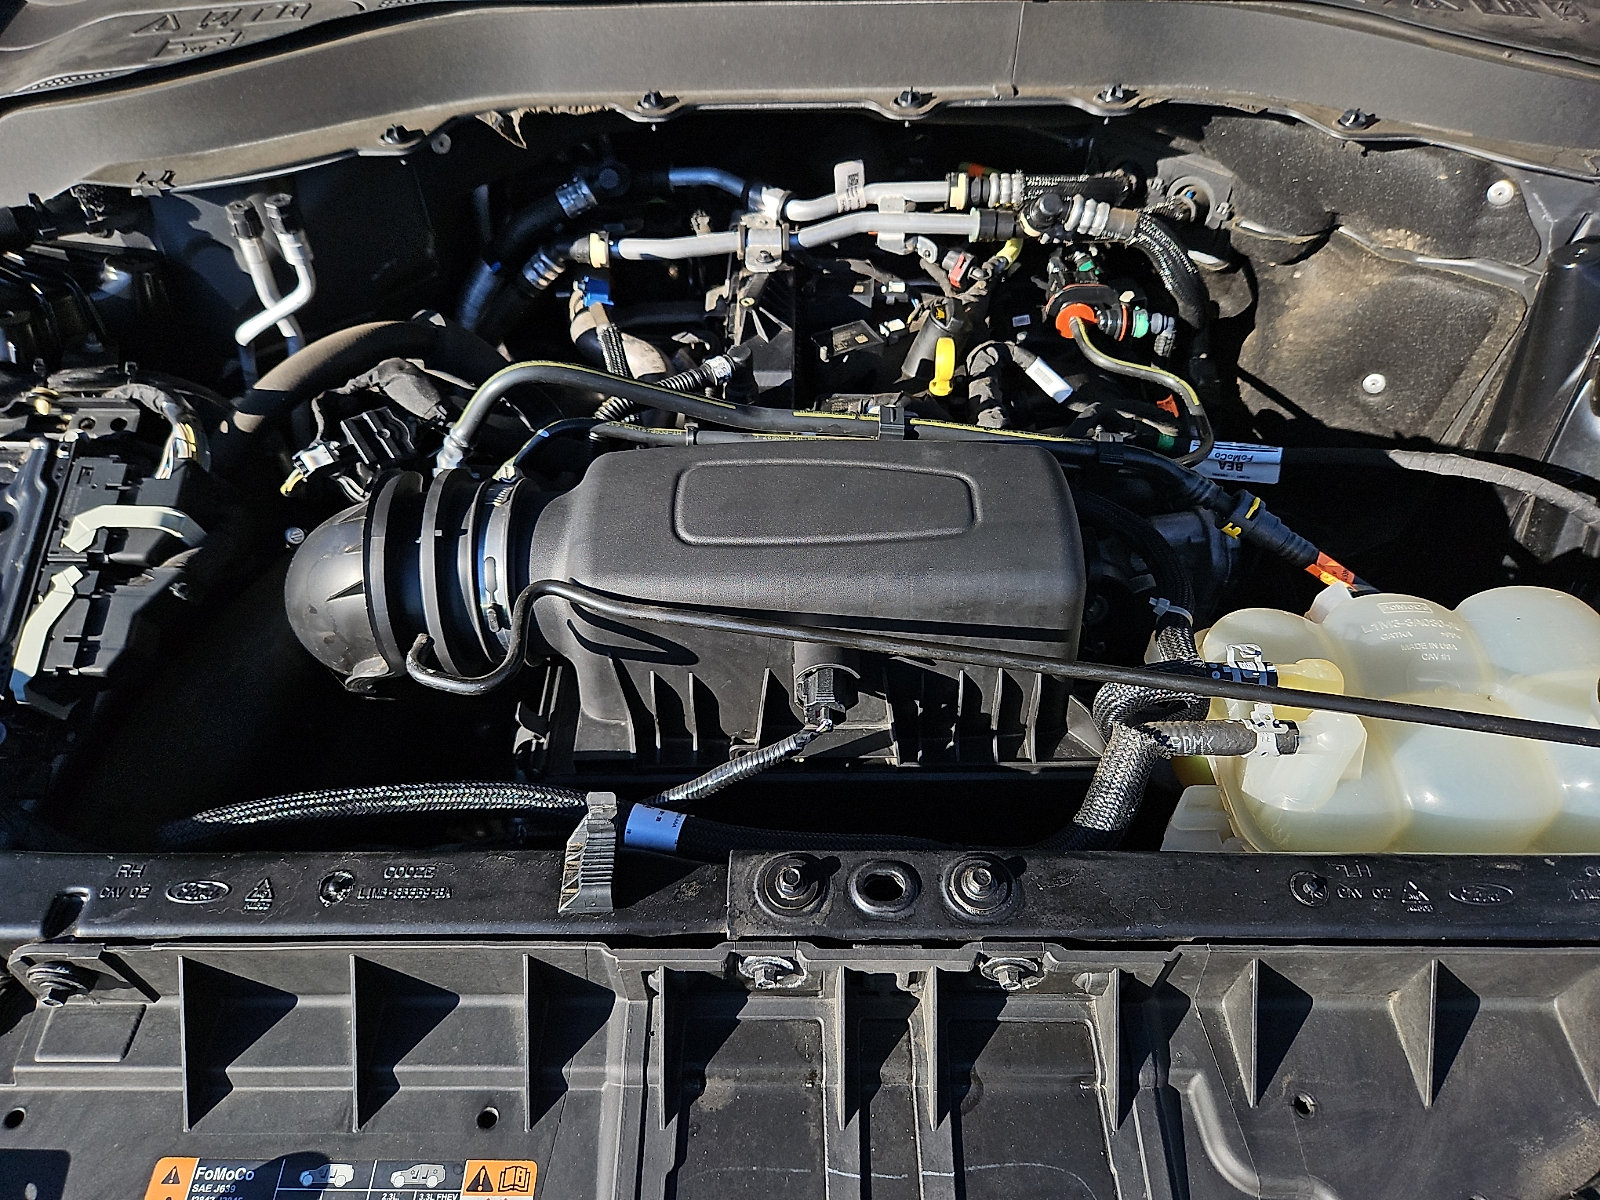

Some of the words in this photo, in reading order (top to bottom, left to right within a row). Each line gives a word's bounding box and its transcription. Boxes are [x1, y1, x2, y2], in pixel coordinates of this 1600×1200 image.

[1214, 452, 1254, 463] FoMoCo
[1217, 460, 1245, 472] BEA
[1401, 642, 1428, 651] MADE
[115, 863, 146, 878] RH
[100, 886, 126, 899] CAV
[194, 1166, 255, 1181] FoMoCo
[192, 1184, 213, 1193] SAE
[213, 1184, 236, 1193] J639
